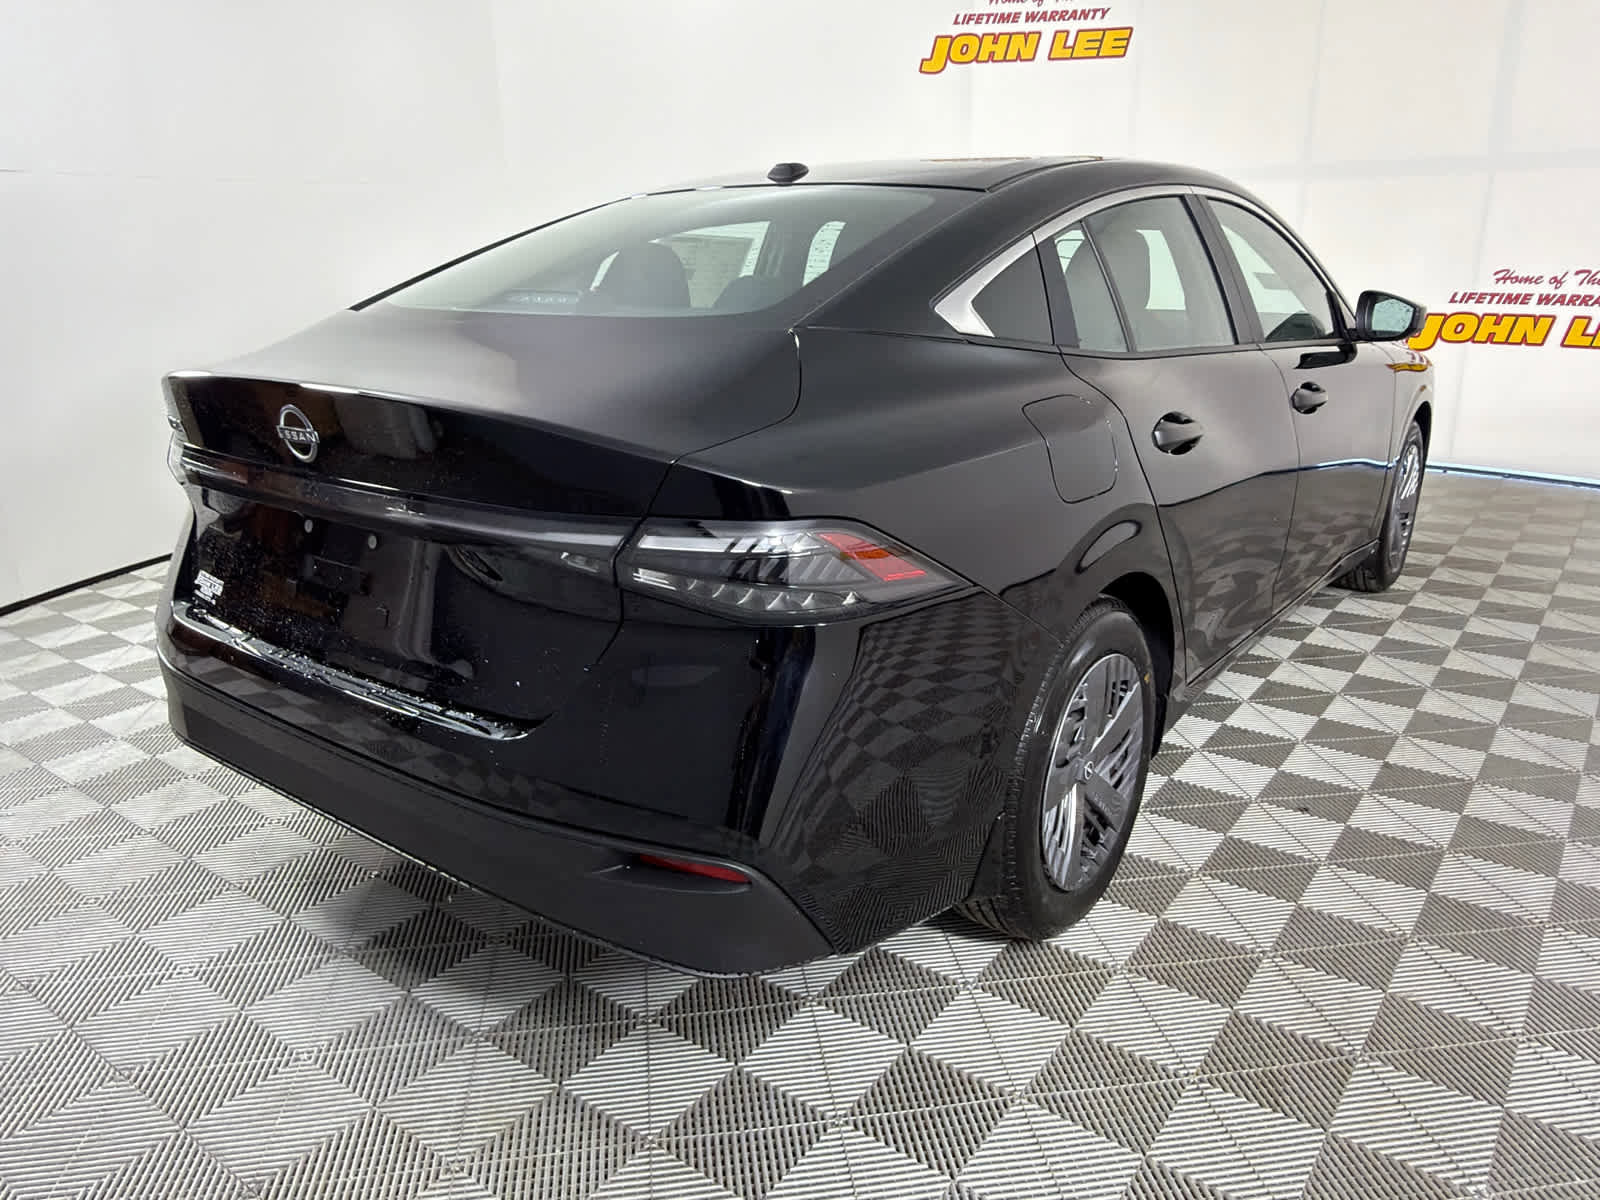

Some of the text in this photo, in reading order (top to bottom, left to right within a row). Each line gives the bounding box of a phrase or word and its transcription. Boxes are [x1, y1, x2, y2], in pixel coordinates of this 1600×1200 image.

[953, 8, 1111, 25] LIFETIME WARRANTY
[919, 27, 1133, 74] JOHN LEE
[1493, 269, 1544, 285] Home
[1549, 271, 1569, 290] of
[1449, 292, 1534, 305] LIFETIME
[1406, 311, 1557, 352] JOHN
